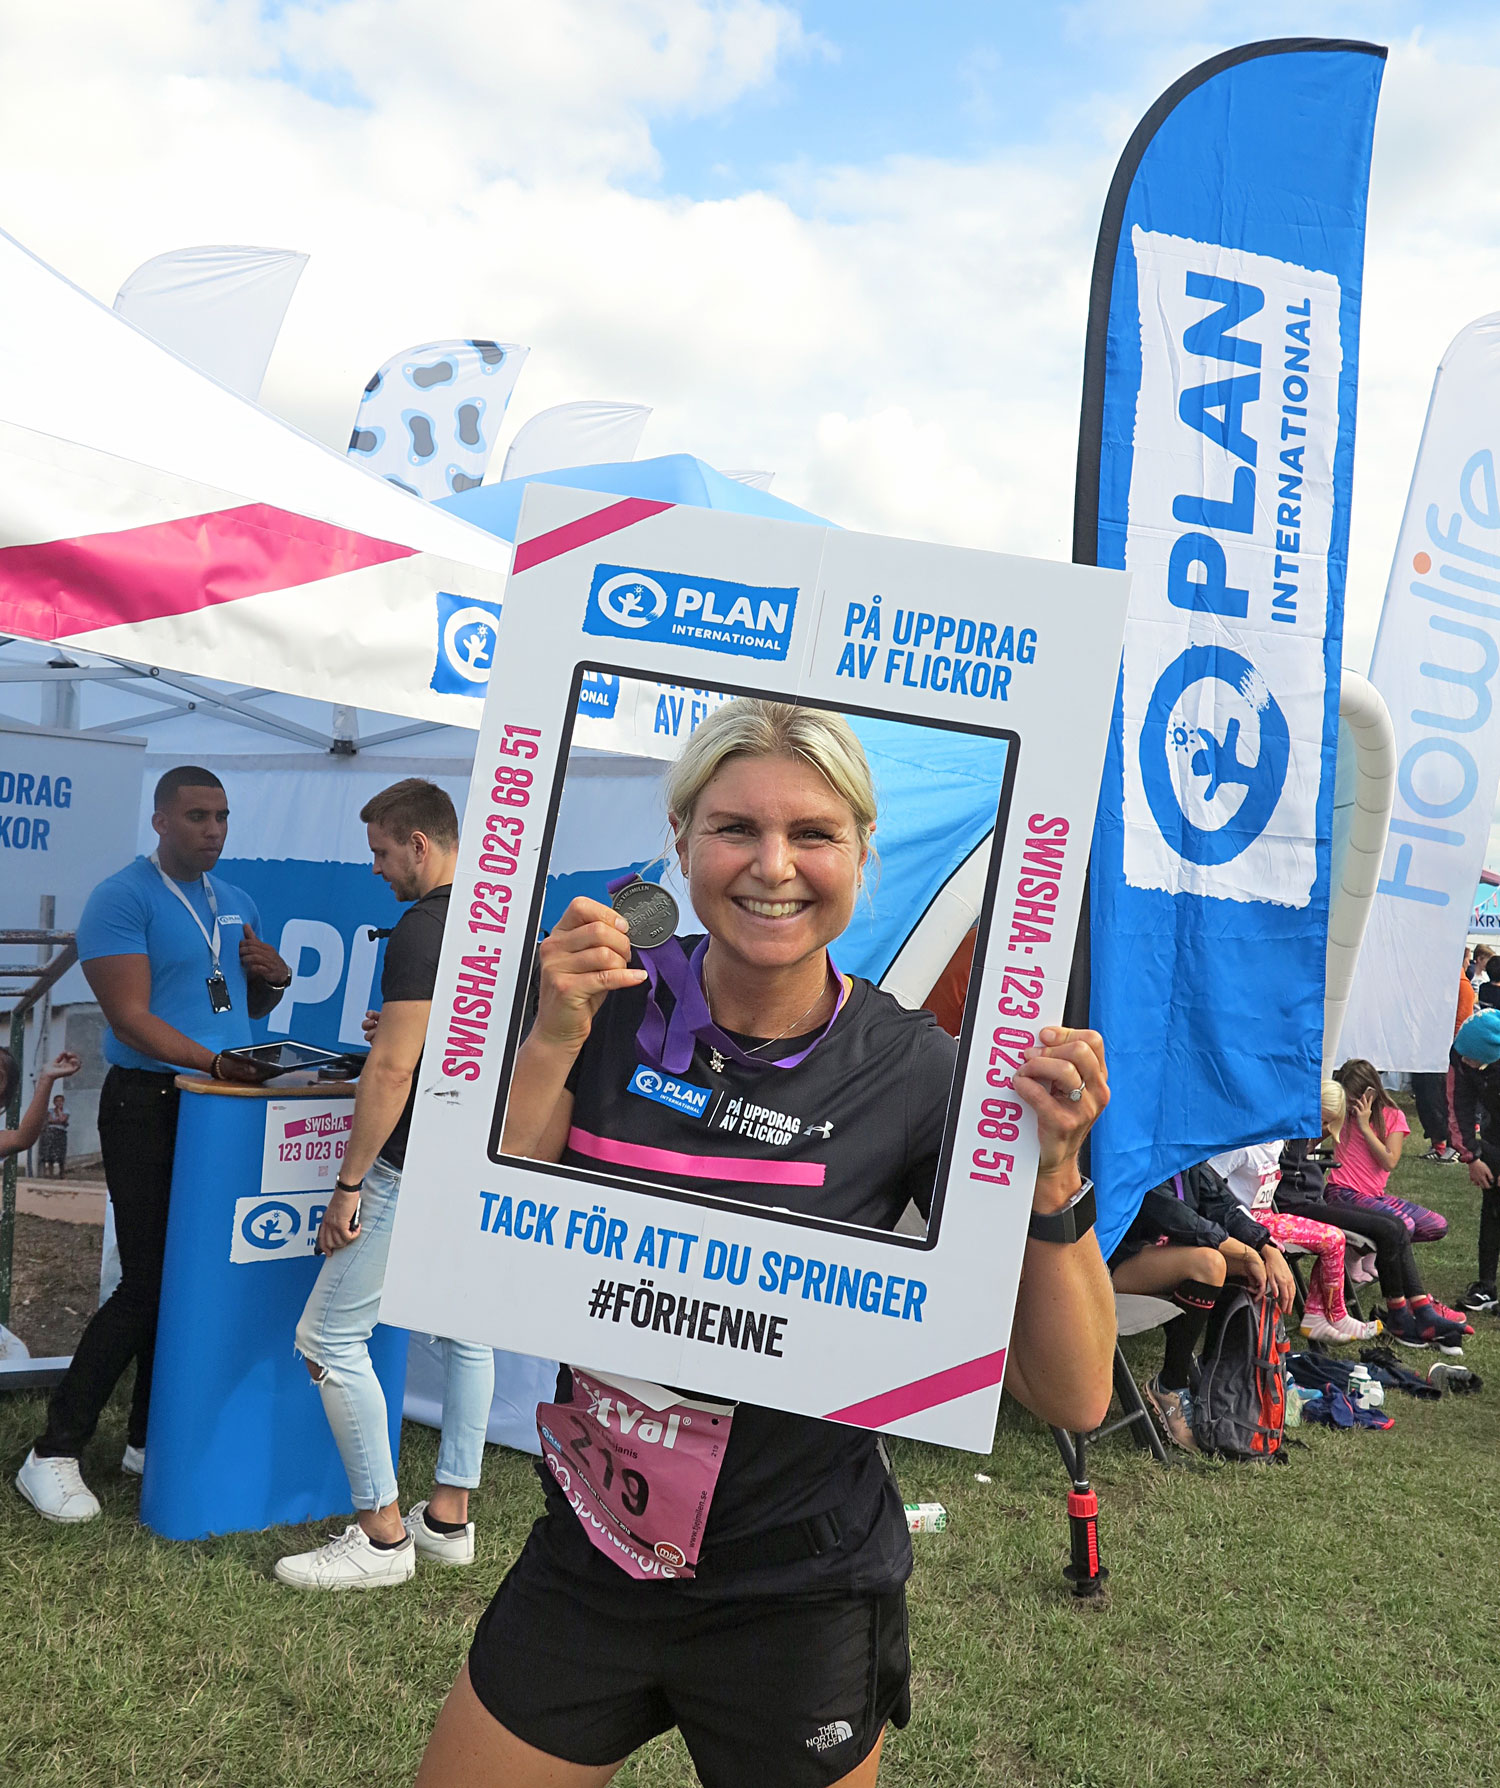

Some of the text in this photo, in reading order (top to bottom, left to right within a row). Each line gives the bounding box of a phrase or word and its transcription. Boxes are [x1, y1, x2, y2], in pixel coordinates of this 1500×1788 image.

[1168, 271, 1265, 619] PLAN
[1271, 298, 1311, 624] INTERNATIONAL
[674, 586, 789, 634] PLAN
[844, 594, 1037, 664] PÅ UPPDRAG
[671, 623, 782, 651] INTERNATIONAL
[836, 641, 1013, 702] AV FLICKOR
[654, 694, 684, 736] AV
[442, 723, 542, 1081] SWISHA: 123 023 68 51
[1008, 813, 1069, 955] SWISHA:
[998, 964, 1043, 1020] 123
[659, 1094, 700, 1114] INTERNATIONAL
[663, 1081, 707, 1107] PLAN
[304, 1116, 348, 1132] SWISHA:
[719, 1114, 793, 1146] AV FLICKOR
[726, 1097, 801, 1134] PÅ UPPDRAG
[977, 1098, 1023, 1141] 68
[278, 1142, 302, 1162] 123
[305, 1141, 331, 1160] 023
[970, 1149, 1015, 1186] 51
[479, 1191, 928, 1323] TACK FÖR ATT DU SPRINGER
[588, 1279, 789, 1359] #FÖRHENNE
[805, 1728, 838, 1748] NORTH
[816, 1736, 839, 1752] FACE
[818, 1722, 836, 1736] THE
